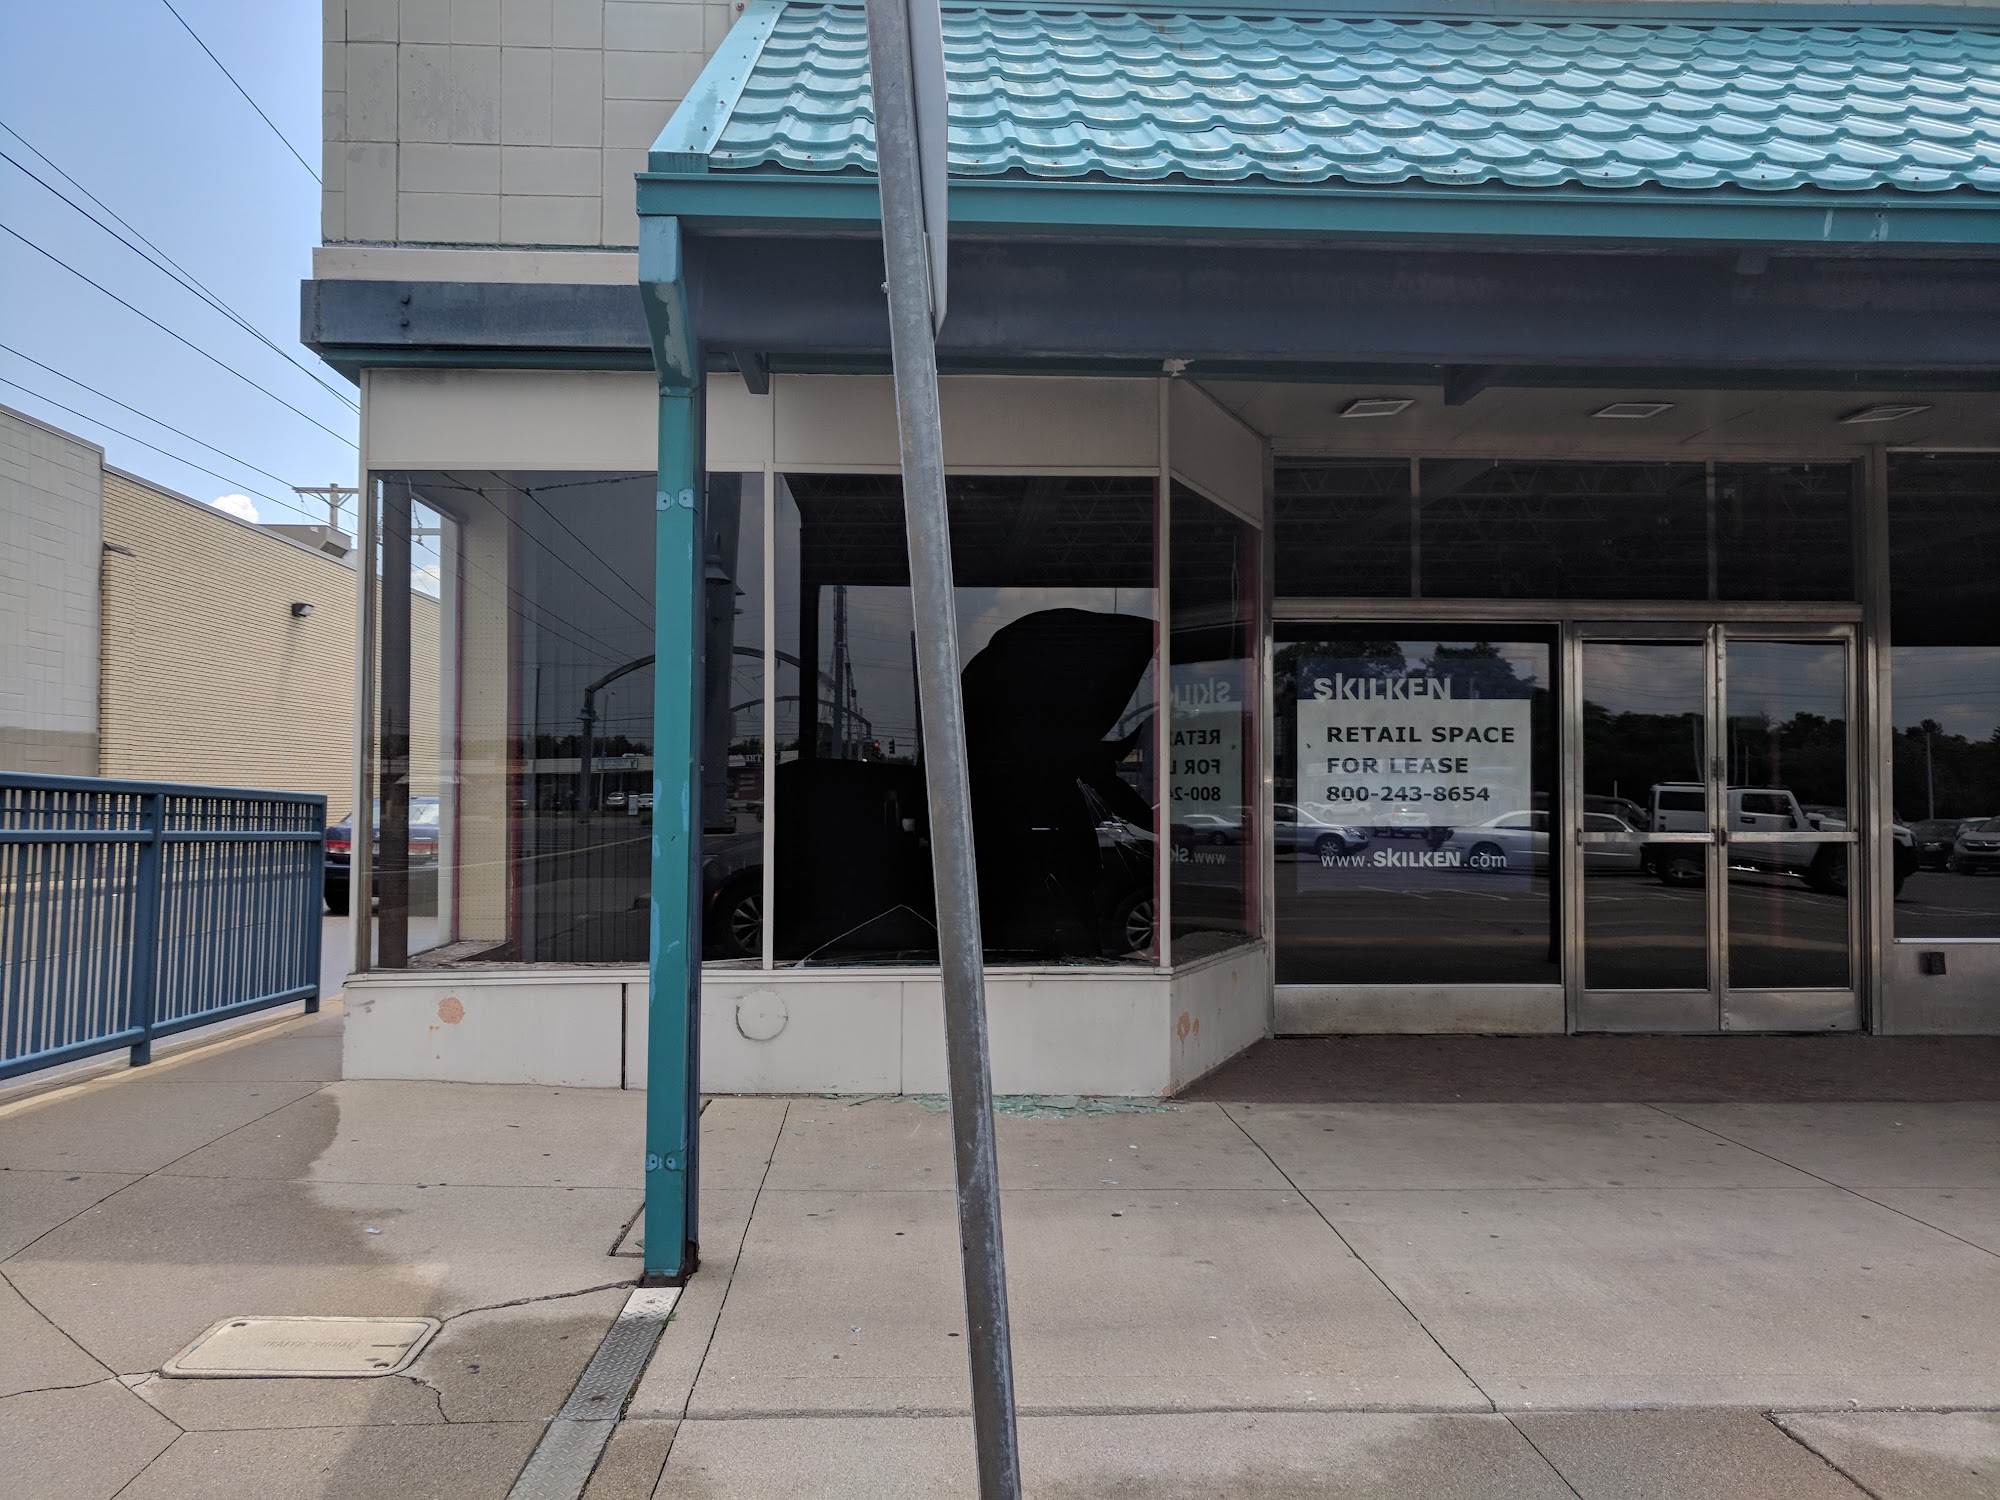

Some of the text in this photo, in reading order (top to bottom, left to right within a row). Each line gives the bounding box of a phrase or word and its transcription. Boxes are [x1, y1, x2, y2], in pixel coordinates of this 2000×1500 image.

[1313, 672, 1451, 700] SKILKEN
[1326, 726, 1515, 743] RETAIL SPACE
[1326, 757, 1468, 774] FOR LEASE
[1326, 786, 1490, 802] 800-243-8654
